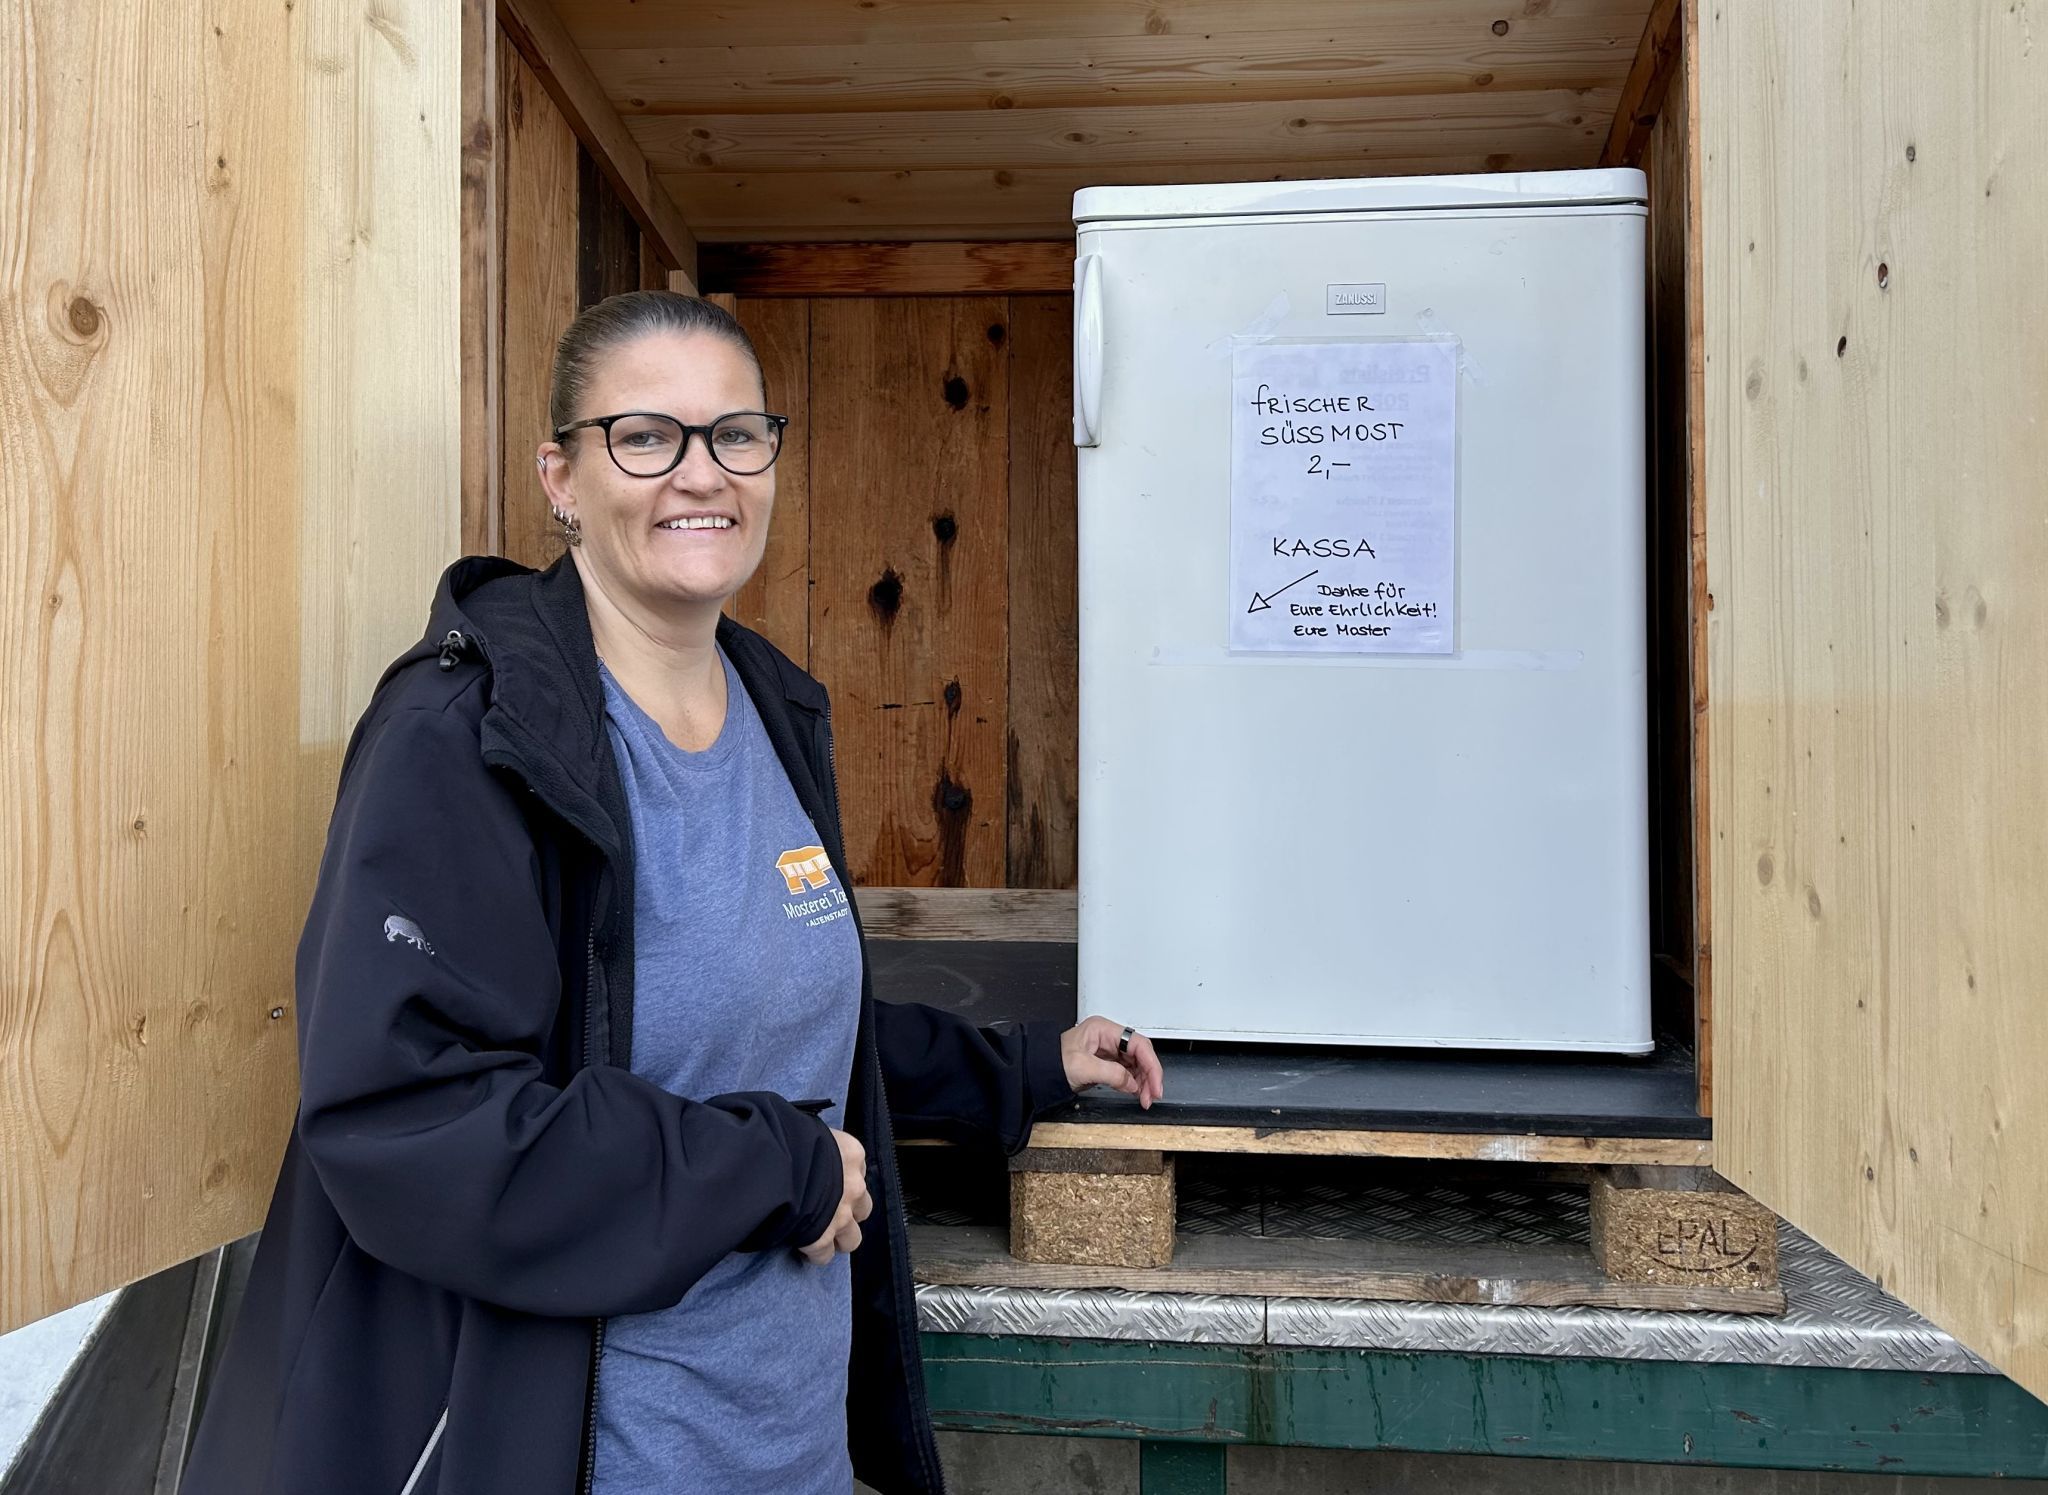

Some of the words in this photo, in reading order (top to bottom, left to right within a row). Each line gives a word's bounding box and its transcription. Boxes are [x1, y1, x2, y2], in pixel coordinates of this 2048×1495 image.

[1335, 293, 1377, 306] ZANUSSI
[1273, 537, 1376, 559] KASSA
[1317, 584, 1369, 597] Danke
[1374, 582, 1405, 600] für
[1290, 604, 1323, 617] Eure
[1293, 625, 1328, 637] Eure
[783, 893, 832, 919] Mosterei
[809, 908, 848, 927] ALTENSTADT
[1657, 1219, 1742, 1256] EPAL
